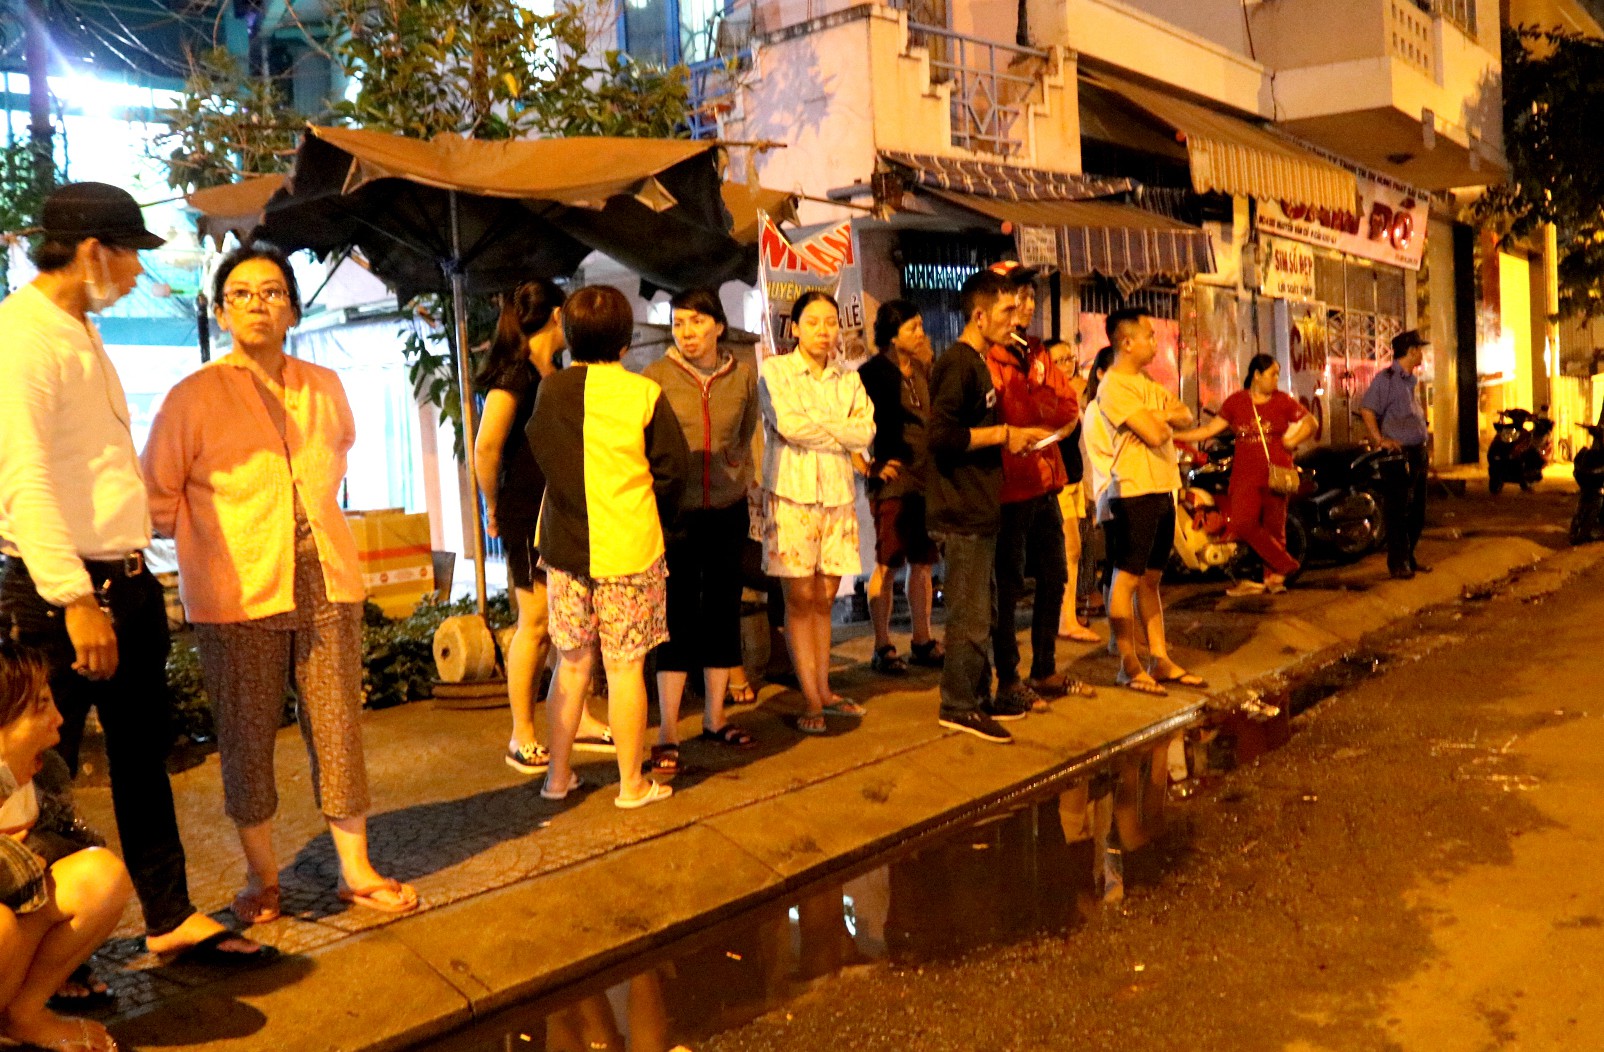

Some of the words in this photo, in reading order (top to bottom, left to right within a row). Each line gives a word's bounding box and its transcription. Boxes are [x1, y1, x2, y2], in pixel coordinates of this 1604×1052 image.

[1274, 249, 1288, 272] SIM
[766, 280, 802, 302] HUYÊN
[844, 294, 862, 329] LẺ
